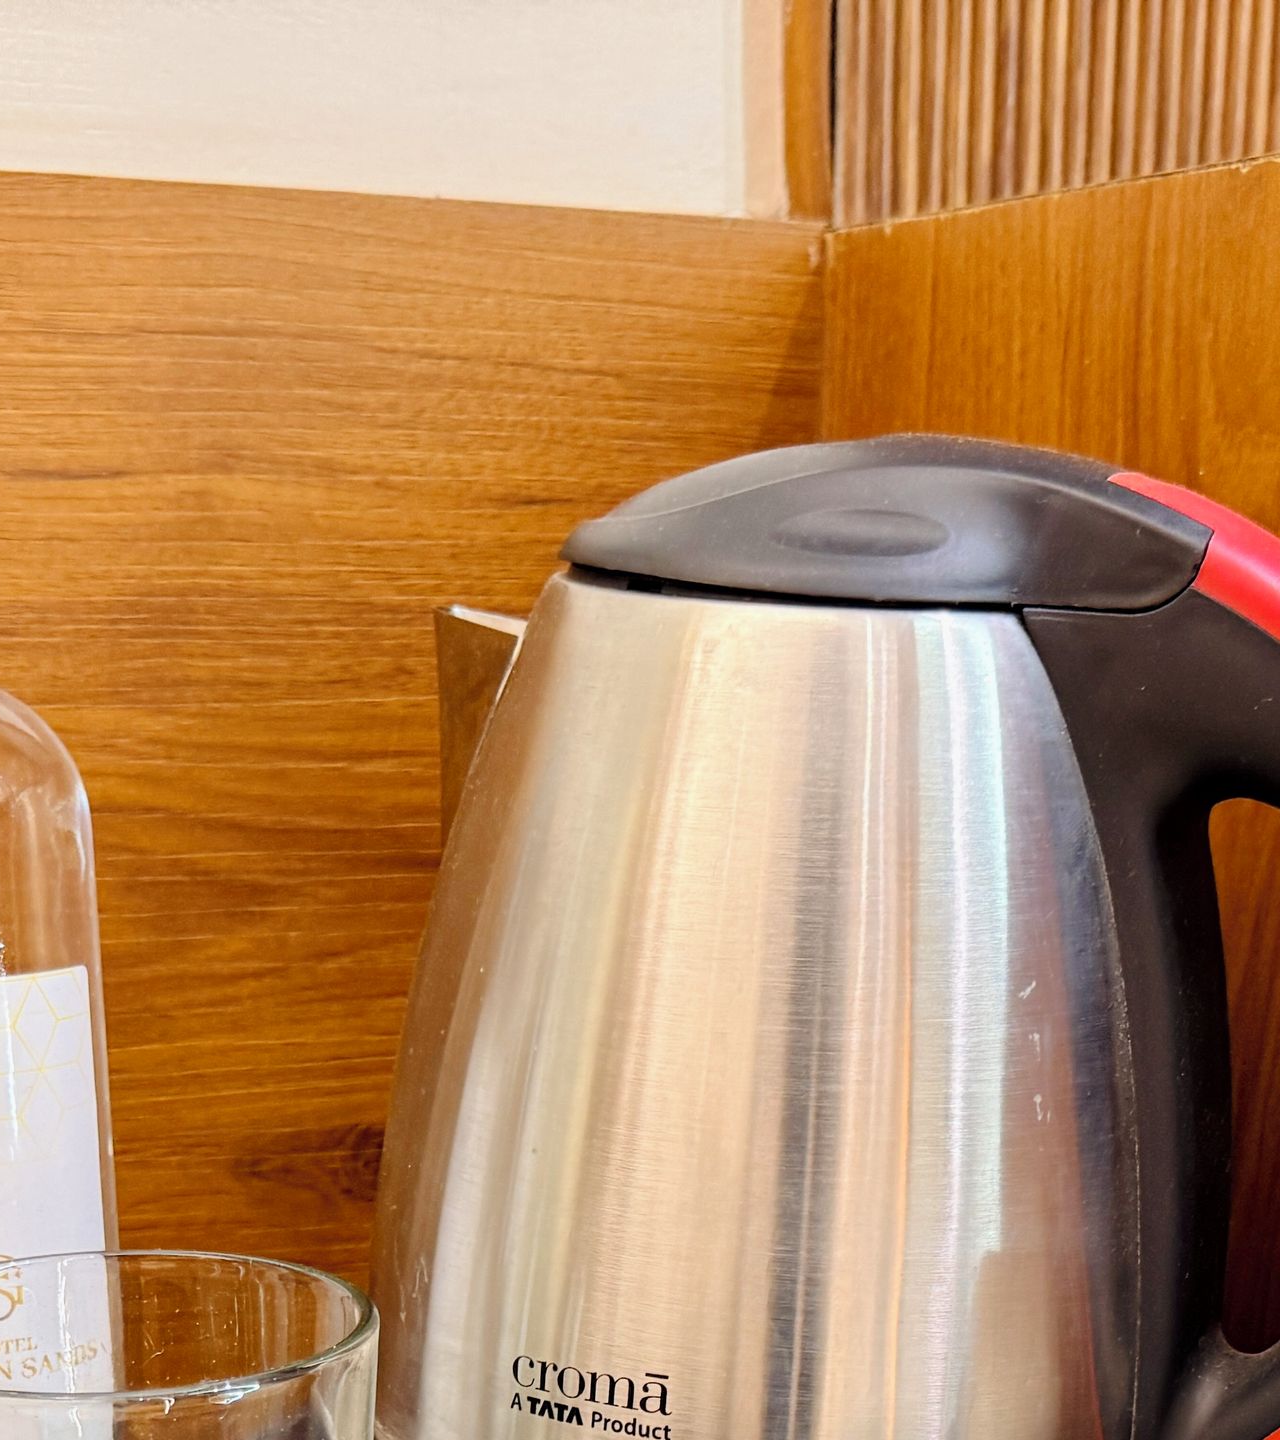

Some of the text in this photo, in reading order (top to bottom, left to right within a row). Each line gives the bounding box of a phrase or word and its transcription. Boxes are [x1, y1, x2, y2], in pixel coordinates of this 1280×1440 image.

[22, 1343, 99, 1380] SANDS
[510, 1392, 523, 1412] A
[526, 1395, 584, 1427] TATA
